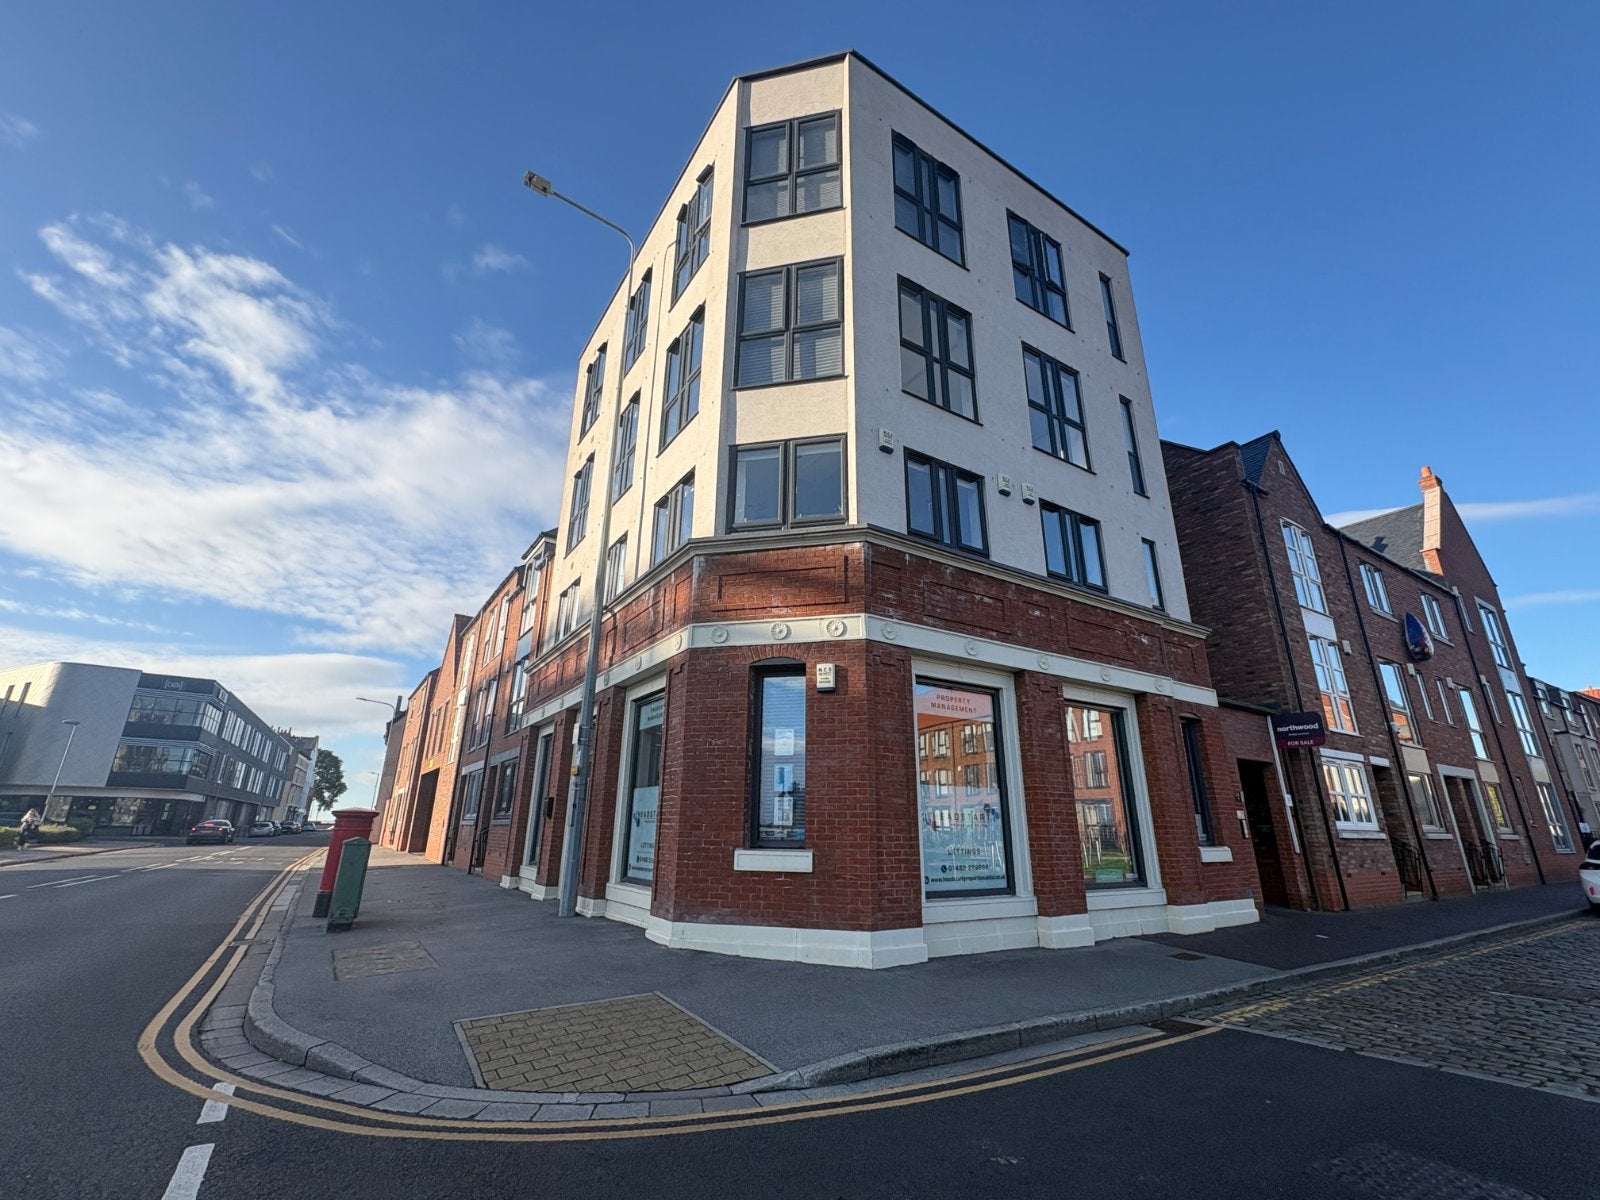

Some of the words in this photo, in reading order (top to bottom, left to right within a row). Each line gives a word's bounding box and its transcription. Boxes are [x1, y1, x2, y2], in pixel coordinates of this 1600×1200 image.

[936, 694, 970, 704] PROPERTY
[930, 702, 977, 713] MANAGEMENT
[1276, 722, 1319, 732] northwood
[933, 811, 990, 822] HEADSTART
[947, 847, 981, 856] LETTINGS
